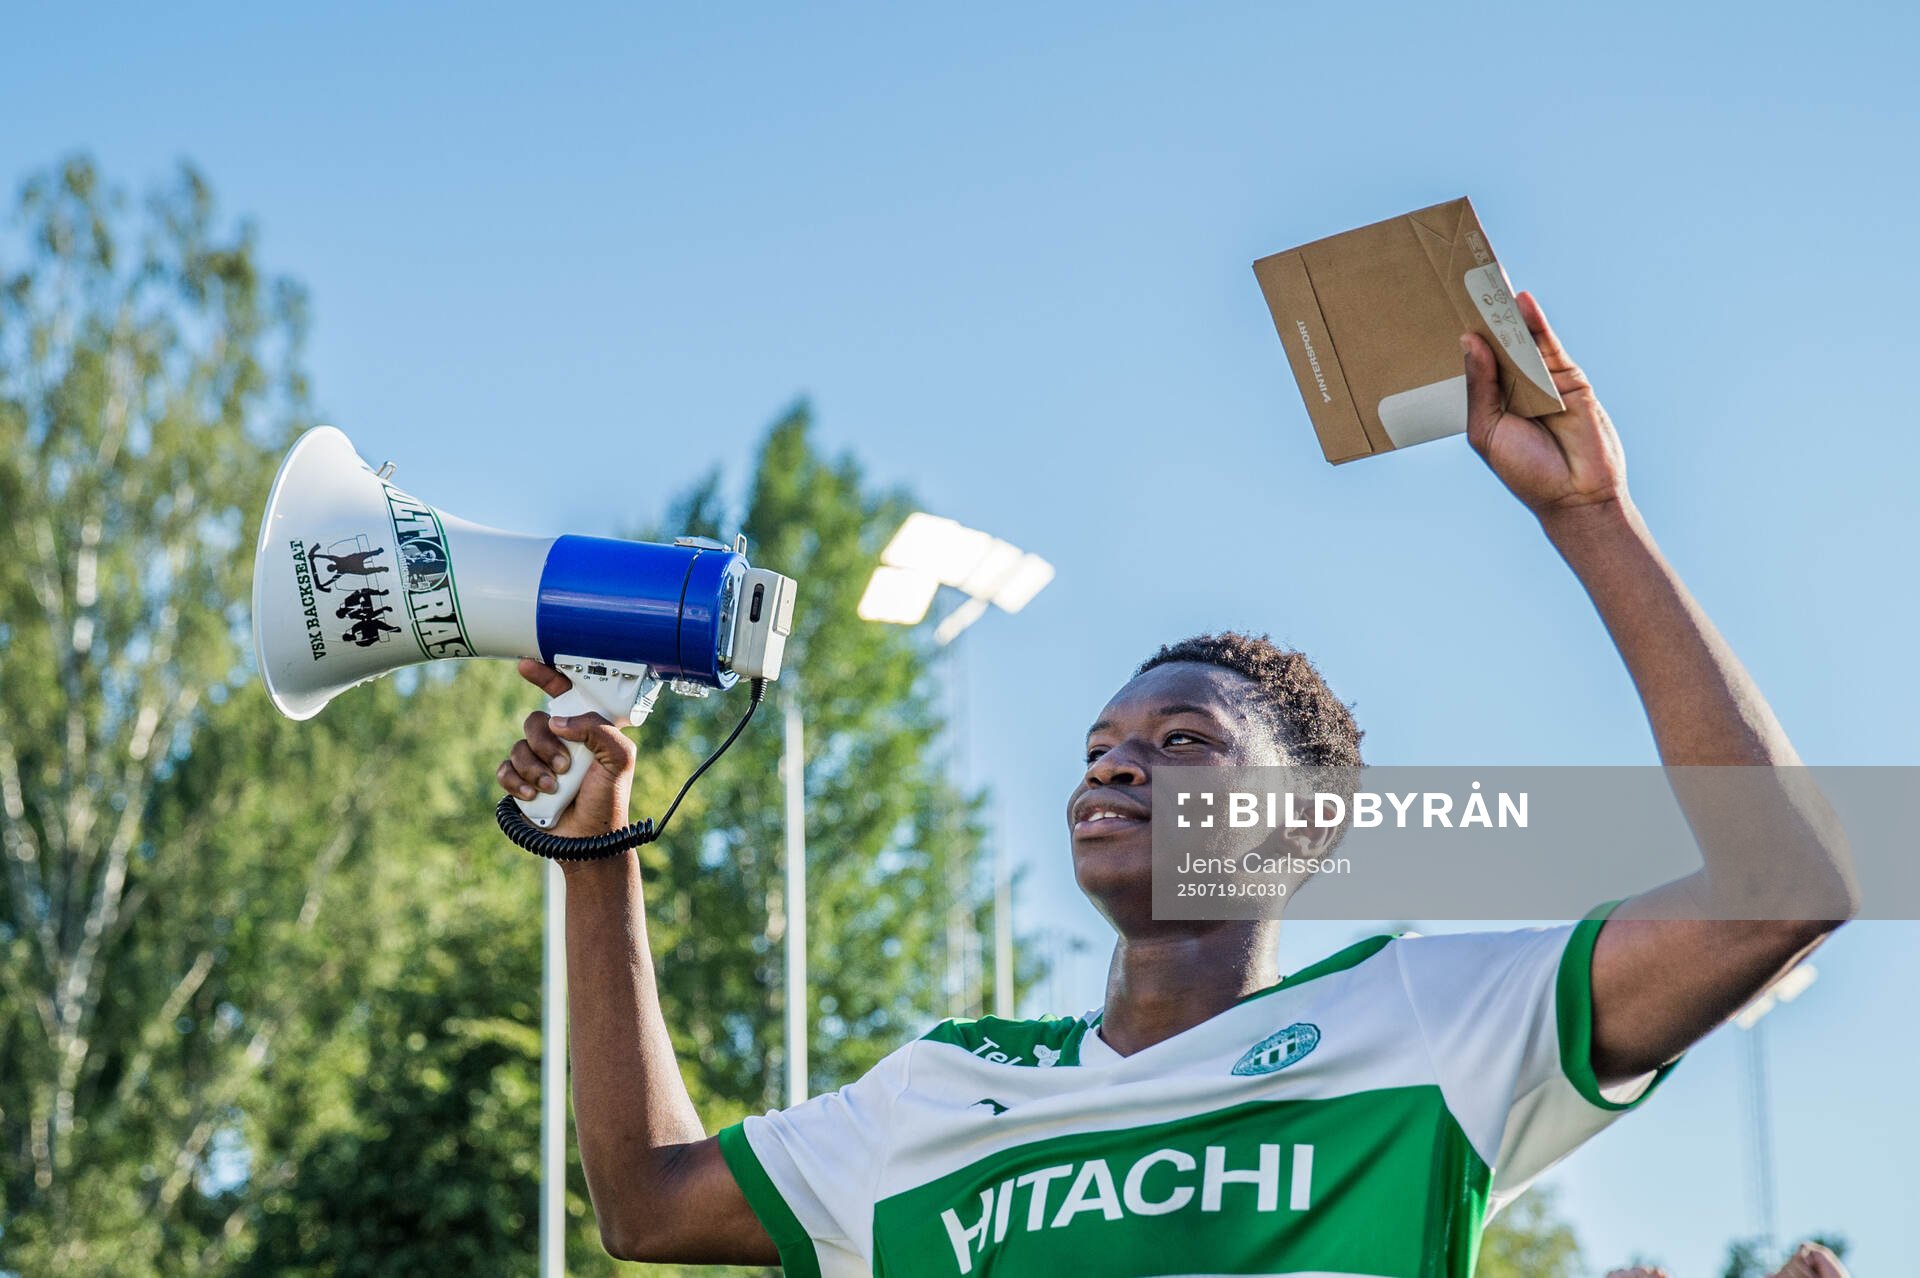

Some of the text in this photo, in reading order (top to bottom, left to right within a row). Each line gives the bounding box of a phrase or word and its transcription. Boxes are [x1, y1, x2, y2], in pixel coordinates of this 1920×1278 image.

[1296, 320, 1327, 392] INTERSPORT
[290, 540, 327, 661] VSK BACKSEAT
[940, 1143, 1315, 1275] HITACHI
